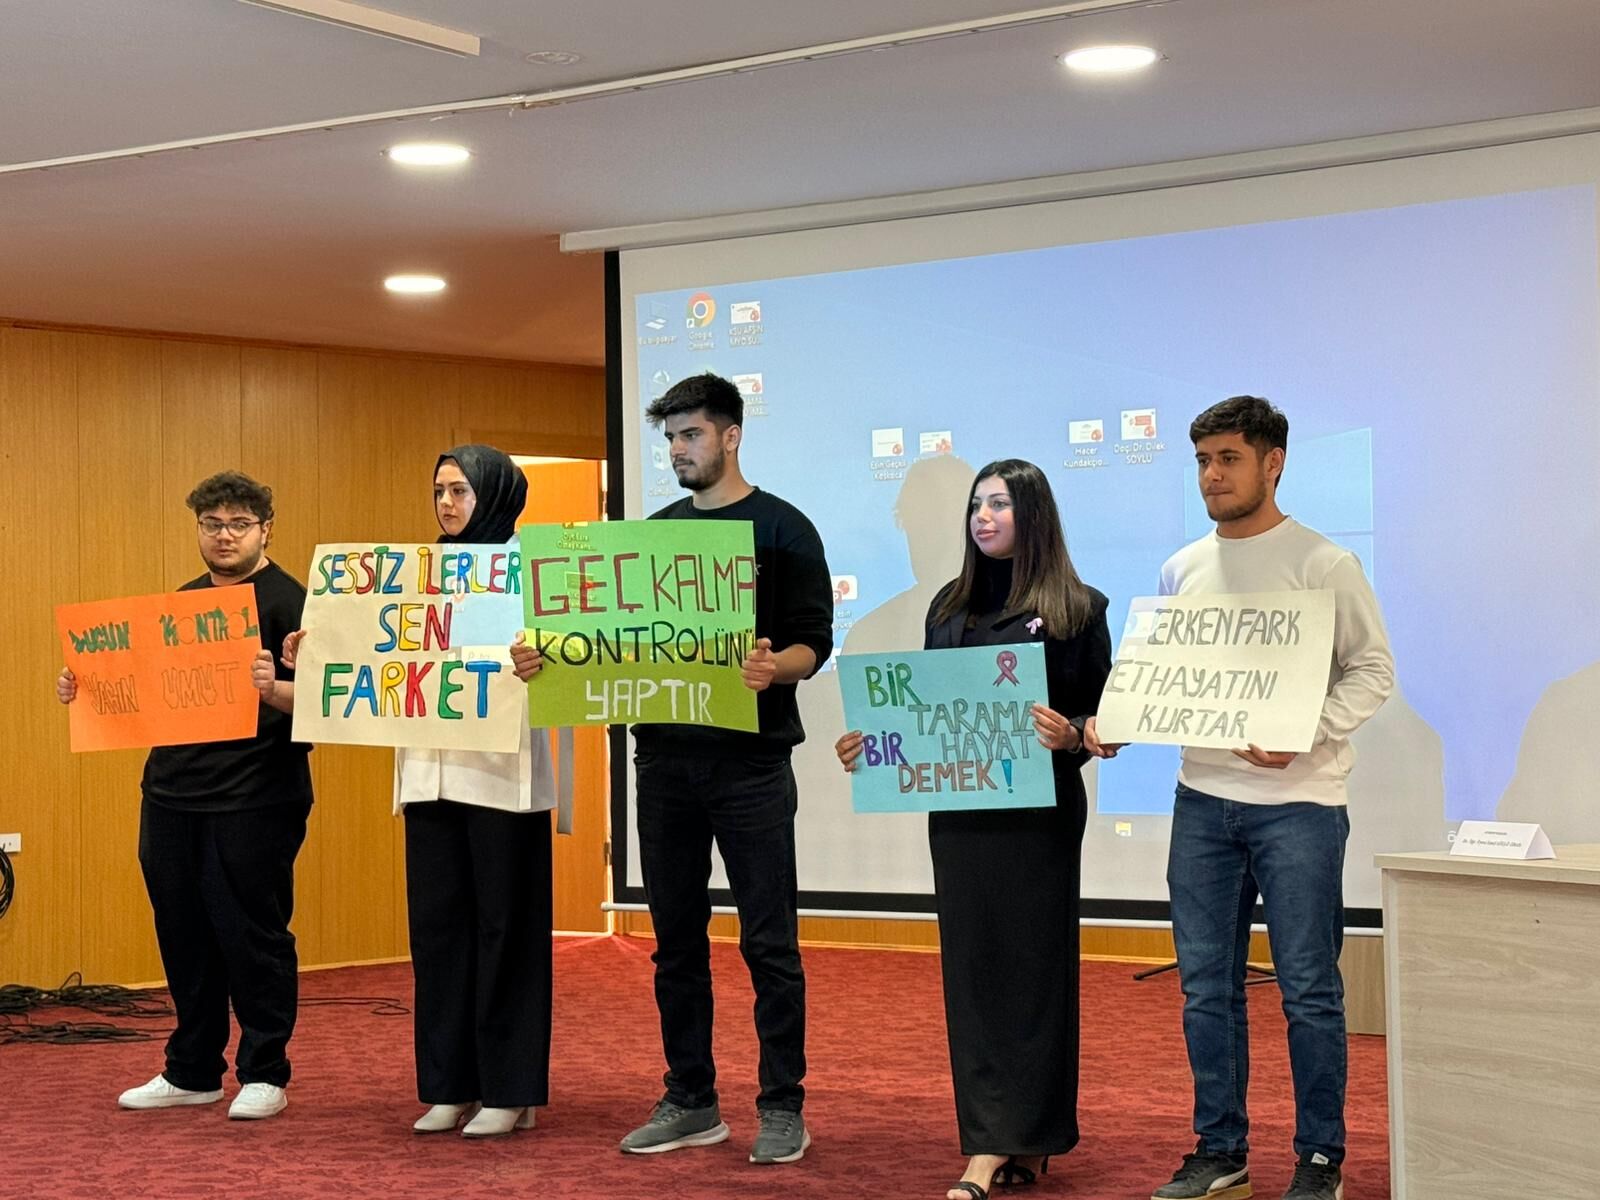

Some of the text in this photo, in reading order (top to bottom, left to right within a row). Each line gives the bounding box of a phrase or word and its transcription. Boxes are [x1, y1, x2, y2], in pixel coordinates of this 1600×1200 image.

[313, 546, 522, 596] SESSİZ İLERLER
[530, 552, 756, 617] GEÇ KALMA
[159, 606, 259, 647] KONTROL
[375, 602, 453, 652] SEN
[534, 621, 757, 671] KONTROLÜNÜ
[161, 661, 241, 710] UMUT
[585, 679, 713, 723] YAPTIR
[865, 663, 925, 708] BİR
[1136, 704, 1249, 740] KURTAR
[862, 730, 1035, 766] BİR HAYAT
